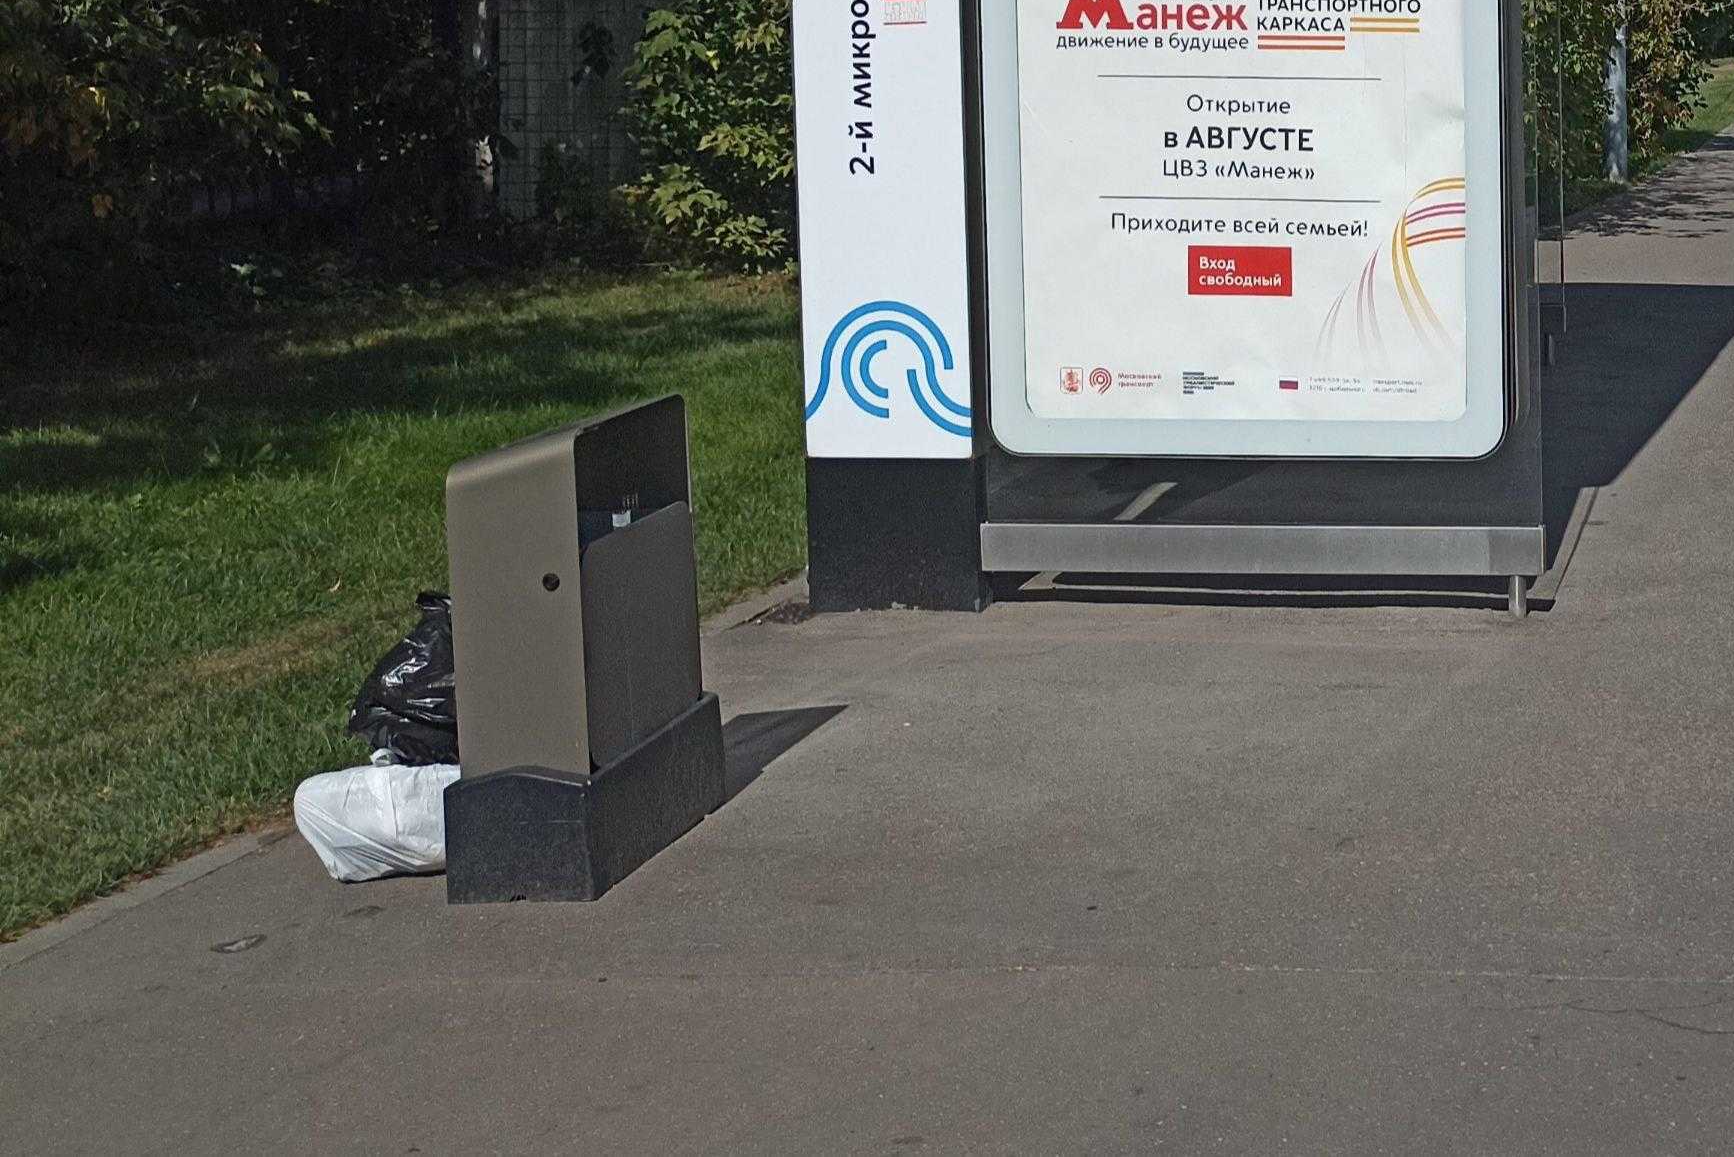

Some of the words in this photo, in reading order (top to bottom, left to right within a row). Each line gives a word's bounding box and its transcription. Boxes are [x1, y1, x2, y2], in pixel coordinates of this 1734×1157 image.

[1257, 16, 1345, 32] КАРКАСА
[1056, 33, 1149, 50] движение
[1154, 37, 1163, 48] в
[1169, 33, 1249, 53] будущее
[1186, 94, 1292, 116] Открытие
[848, 121, 875, 175] 2-й
[1164, 131, 1178, 148] в
[1185, 125, 1314, 152] АВГУСТЕ
[1163, 159, 1208, 179] ЦВЗ
[1215, 160, 1315, 180] «Манеж»
[1111, 212, 1227, 234] Приходите
[1233, 217, 1280, 235] всей
[1285, 219, 1369, 238] семьей!
[1199, 256, 1236, 271] Вход
[1198, 272, 1282, 288] свободный
